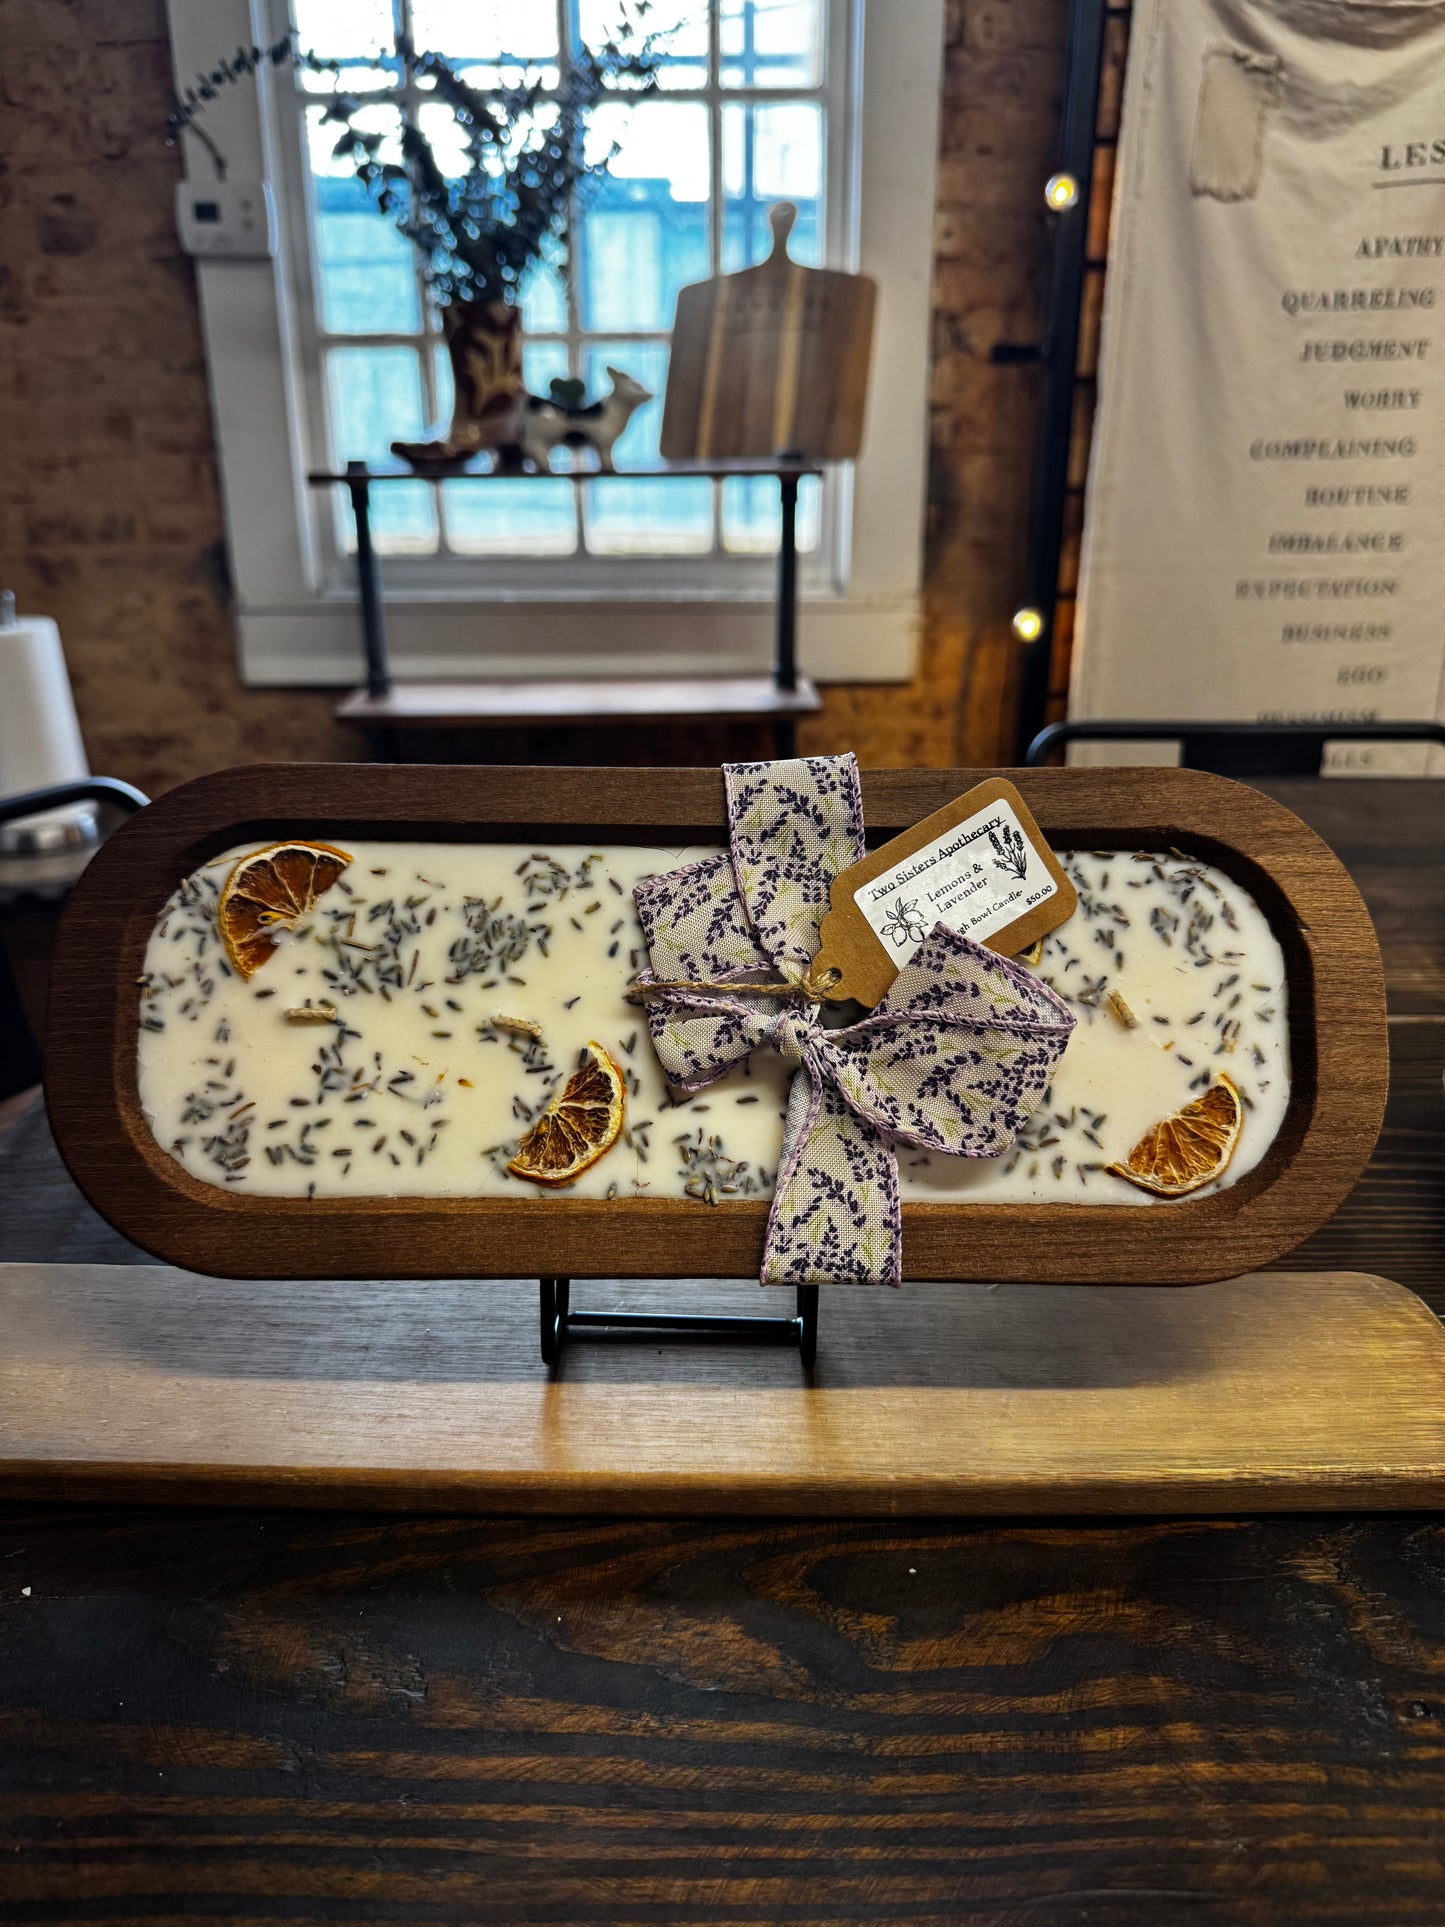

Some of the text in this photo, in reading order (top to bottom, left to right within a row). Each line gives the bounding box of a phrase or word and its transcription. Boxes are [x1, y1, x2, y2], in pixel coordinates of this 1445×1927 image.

[1355, 236, 1445, 258] APATHY
[1281, 287, 1436, 316] QUARRELING
[1300, 339, 1430, 362] JUDGMENT
[1344, 388, 1421, 410] WORRY
[1250, 437, 1417, 461] COMPLAINING
[1305, 484, 1411, 507] ROUTINE
[868, 816, 1003, 903] Two Sisters Apothecary
[926, 863, 984, 903] Lemons &
[936, 876, 989, 914] Lavender
[1025, 885, 1053, 906] $50.00
[970, 907, 993, 926] Bowl
